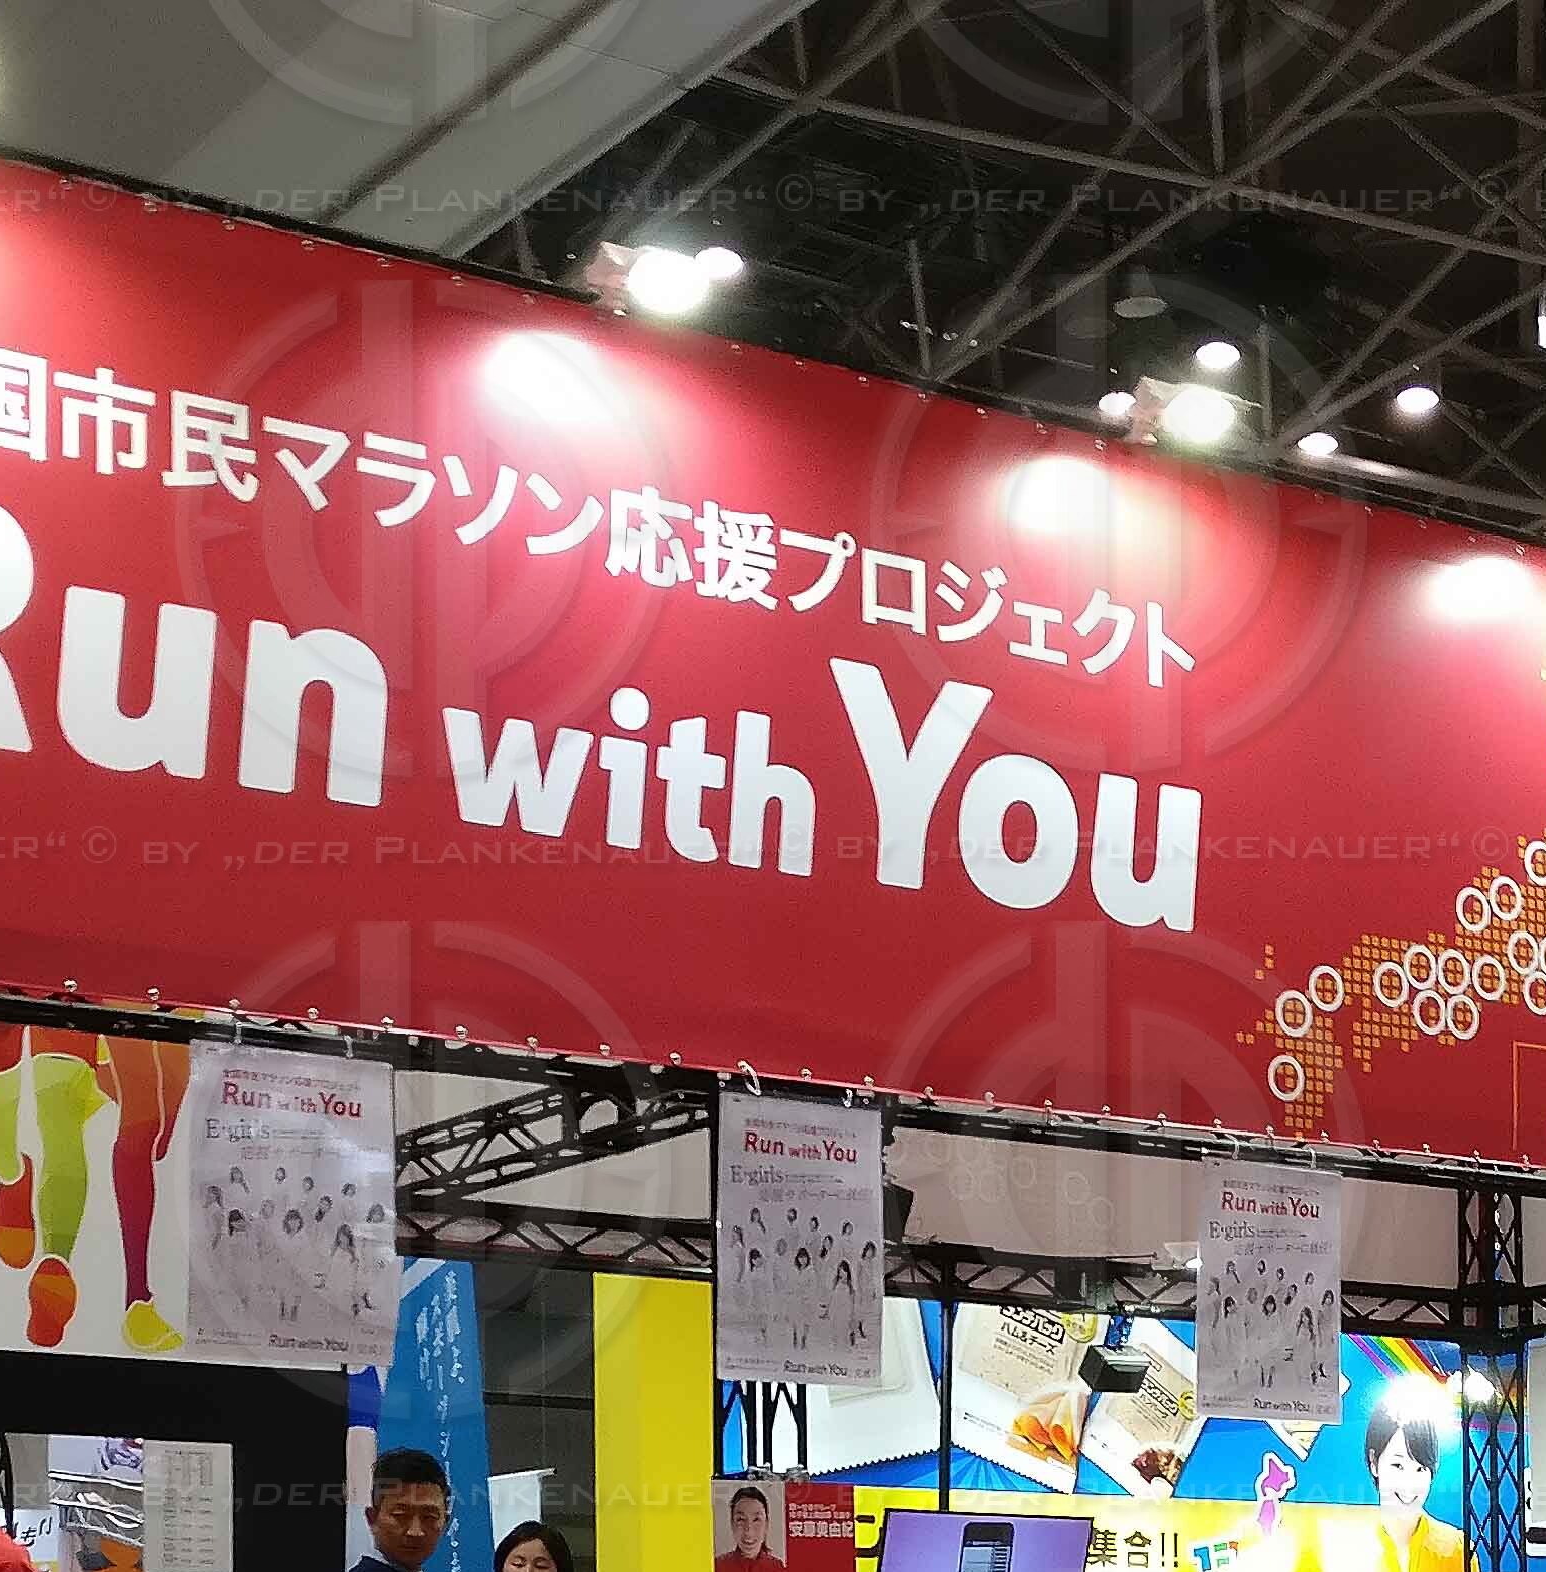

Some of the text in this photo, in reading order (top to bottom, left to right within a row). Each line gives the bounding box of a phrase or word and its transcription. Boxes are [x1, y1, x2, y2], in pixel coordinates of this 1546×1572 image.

[442, 687, 816, 877] with
[830, 656, 1203, 932] You
[221, 1081, 271, 1108] Run
[318, 1091, 362, 1119] You
[743, 1131, 784, 1156] Run
[821, 1140, 858, 1163] You
[1221, 1191, 1320, 1219] Run with You
